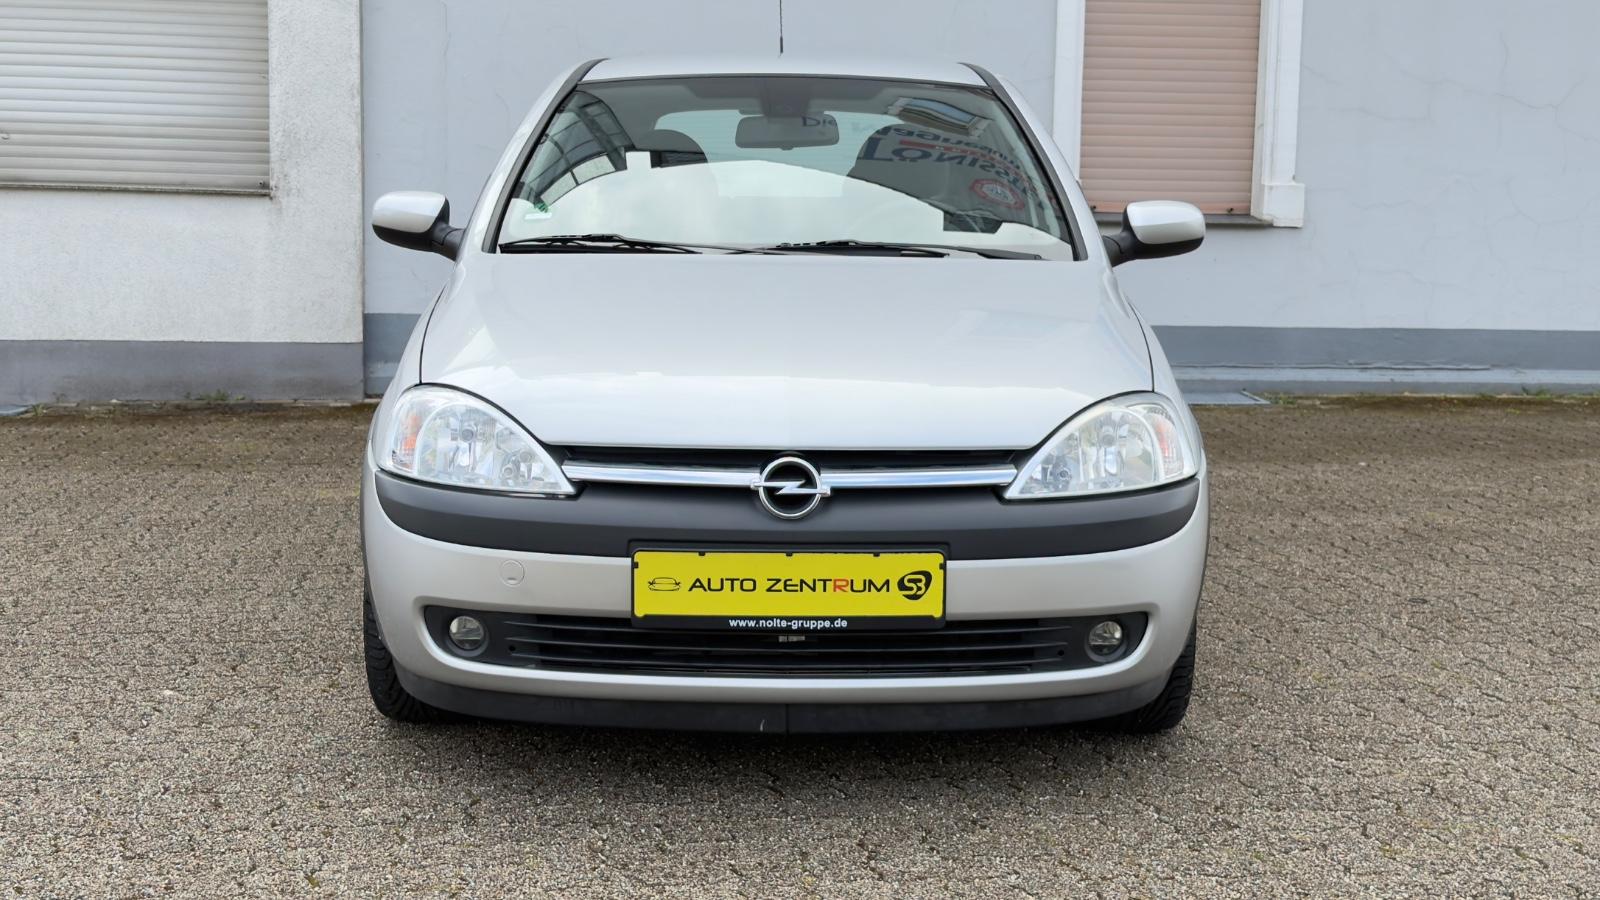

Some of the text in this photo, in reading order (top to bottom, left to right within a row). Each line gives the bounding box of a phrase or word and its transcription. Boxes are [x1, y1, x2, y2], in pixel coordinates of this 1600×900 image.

[688, 578, 757, 592] AUTO
[766, 577, 891, 593] ZENTRUM
[728, 617, 849, 630] www.nolte-gruppe.de
